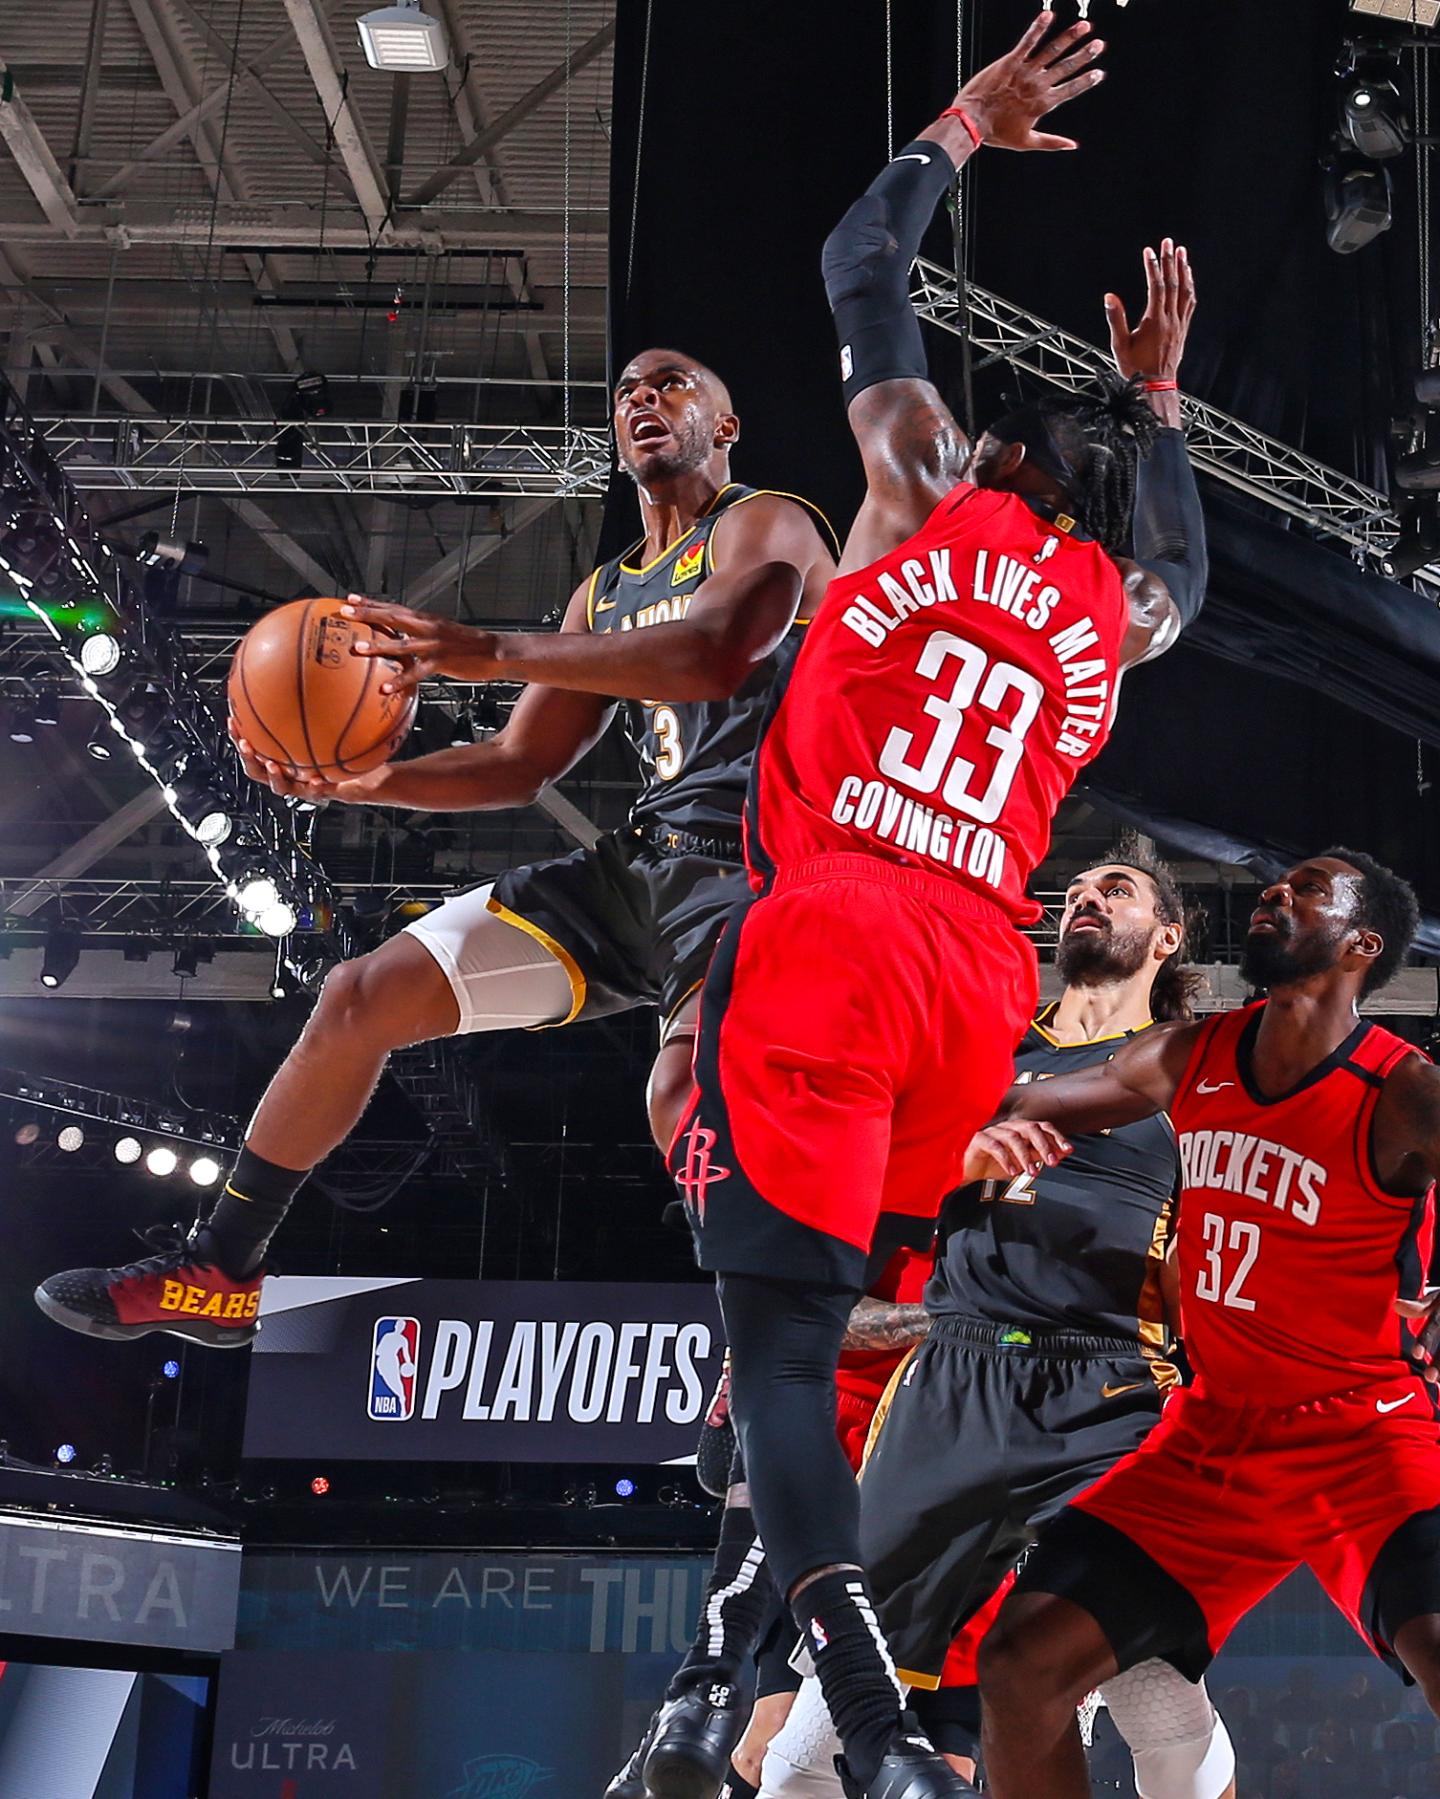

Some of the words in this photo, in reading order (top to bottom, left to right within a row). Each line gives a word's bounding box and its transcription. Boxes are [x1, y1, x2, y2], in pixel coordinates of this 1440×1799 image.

[841, 548, 959, 648] BLACK
[974, 550, 1061, 630] LIVES
[1049, 616, 1110, 758] MATTER
[654, 705, 683, 781] 3
[879, 630, 1044, 823] 33
[831, 775, 1006, 888] COVINGTON
[1178, 1130, 1327, 1226] ROCKETS
[160, 1279, 261, 1319] BEARS
[1195, 1213, 1260, 1311] 32
[375, 1396, 397, 1413] NBA
[421, 1320, 710, 1424] PLAYOFFS
[315, 1565, 410, 1607] WE
[431, 1566, 554, 1609] ARE
[231, 1742, 357, 1770] ULTRA
[250, 1717, 337, 1737] Michelob
